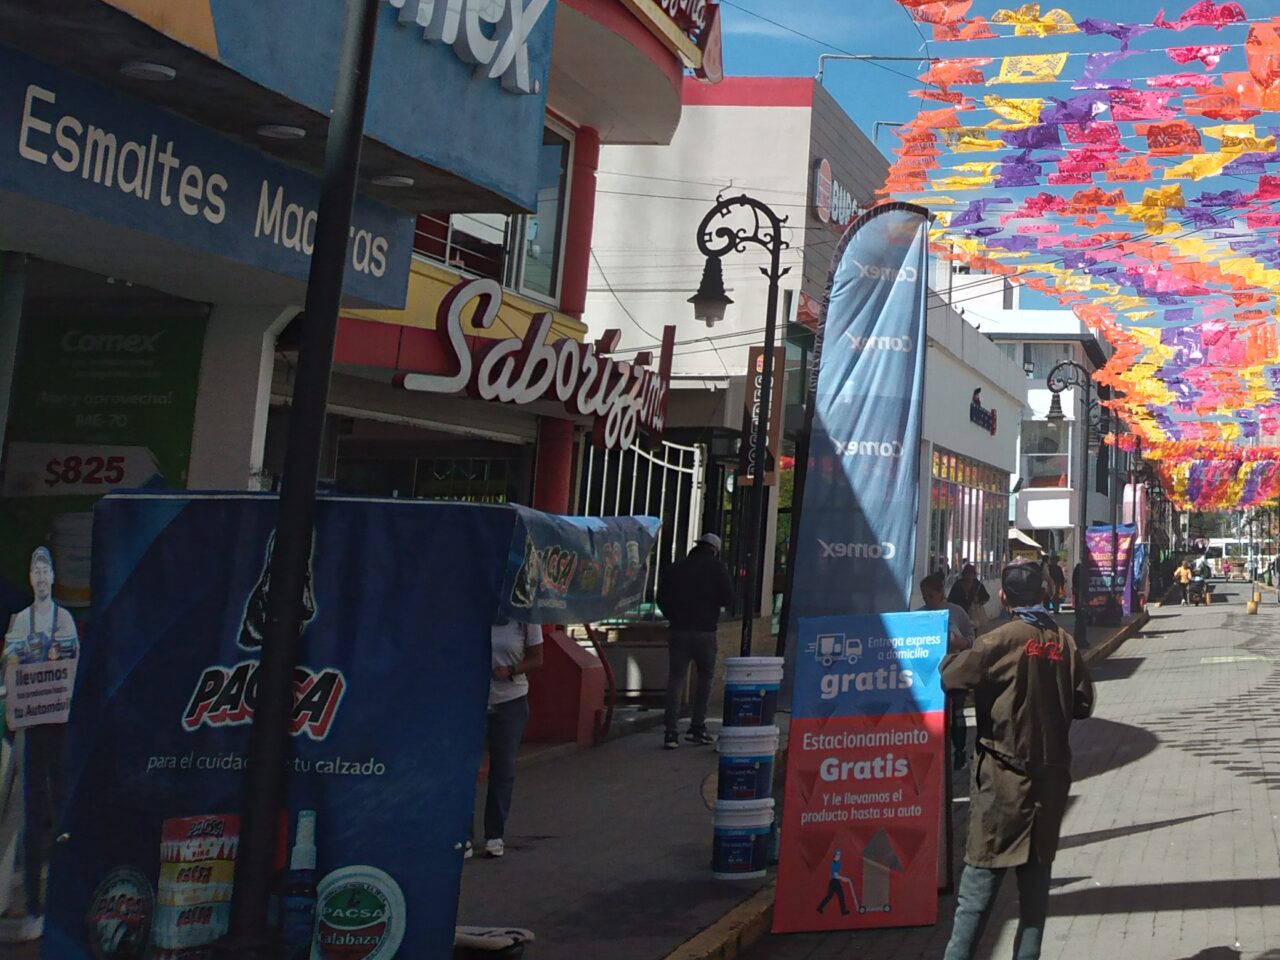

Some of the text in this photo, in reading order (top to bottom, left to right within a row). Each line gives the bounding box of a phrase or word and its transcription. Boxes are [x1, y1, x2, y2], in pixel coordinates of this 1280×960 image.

[19, 84, 389, 278] Esmaltes Maas
[60, 329, 166, 353] Comex
[45, 455, 126, 487] $825
[868, 636, 941, 648] Entrega express
[878, 647, 929, 660] a domicilio
[16, 668, 67, 686] llevamos
[821, 665, 914, 699] gratis
[803, 729, 929, 751] Estacionamiento
[147, 751, 386, 776] para el cuida tu calzado
[820, 753, 909, 782] Gratis
[823, 789, 902, 805] Y le llevamos el
[801, 805, 922, 825] producto hasta su auto
[323, 906, 384, 919] PACSA
